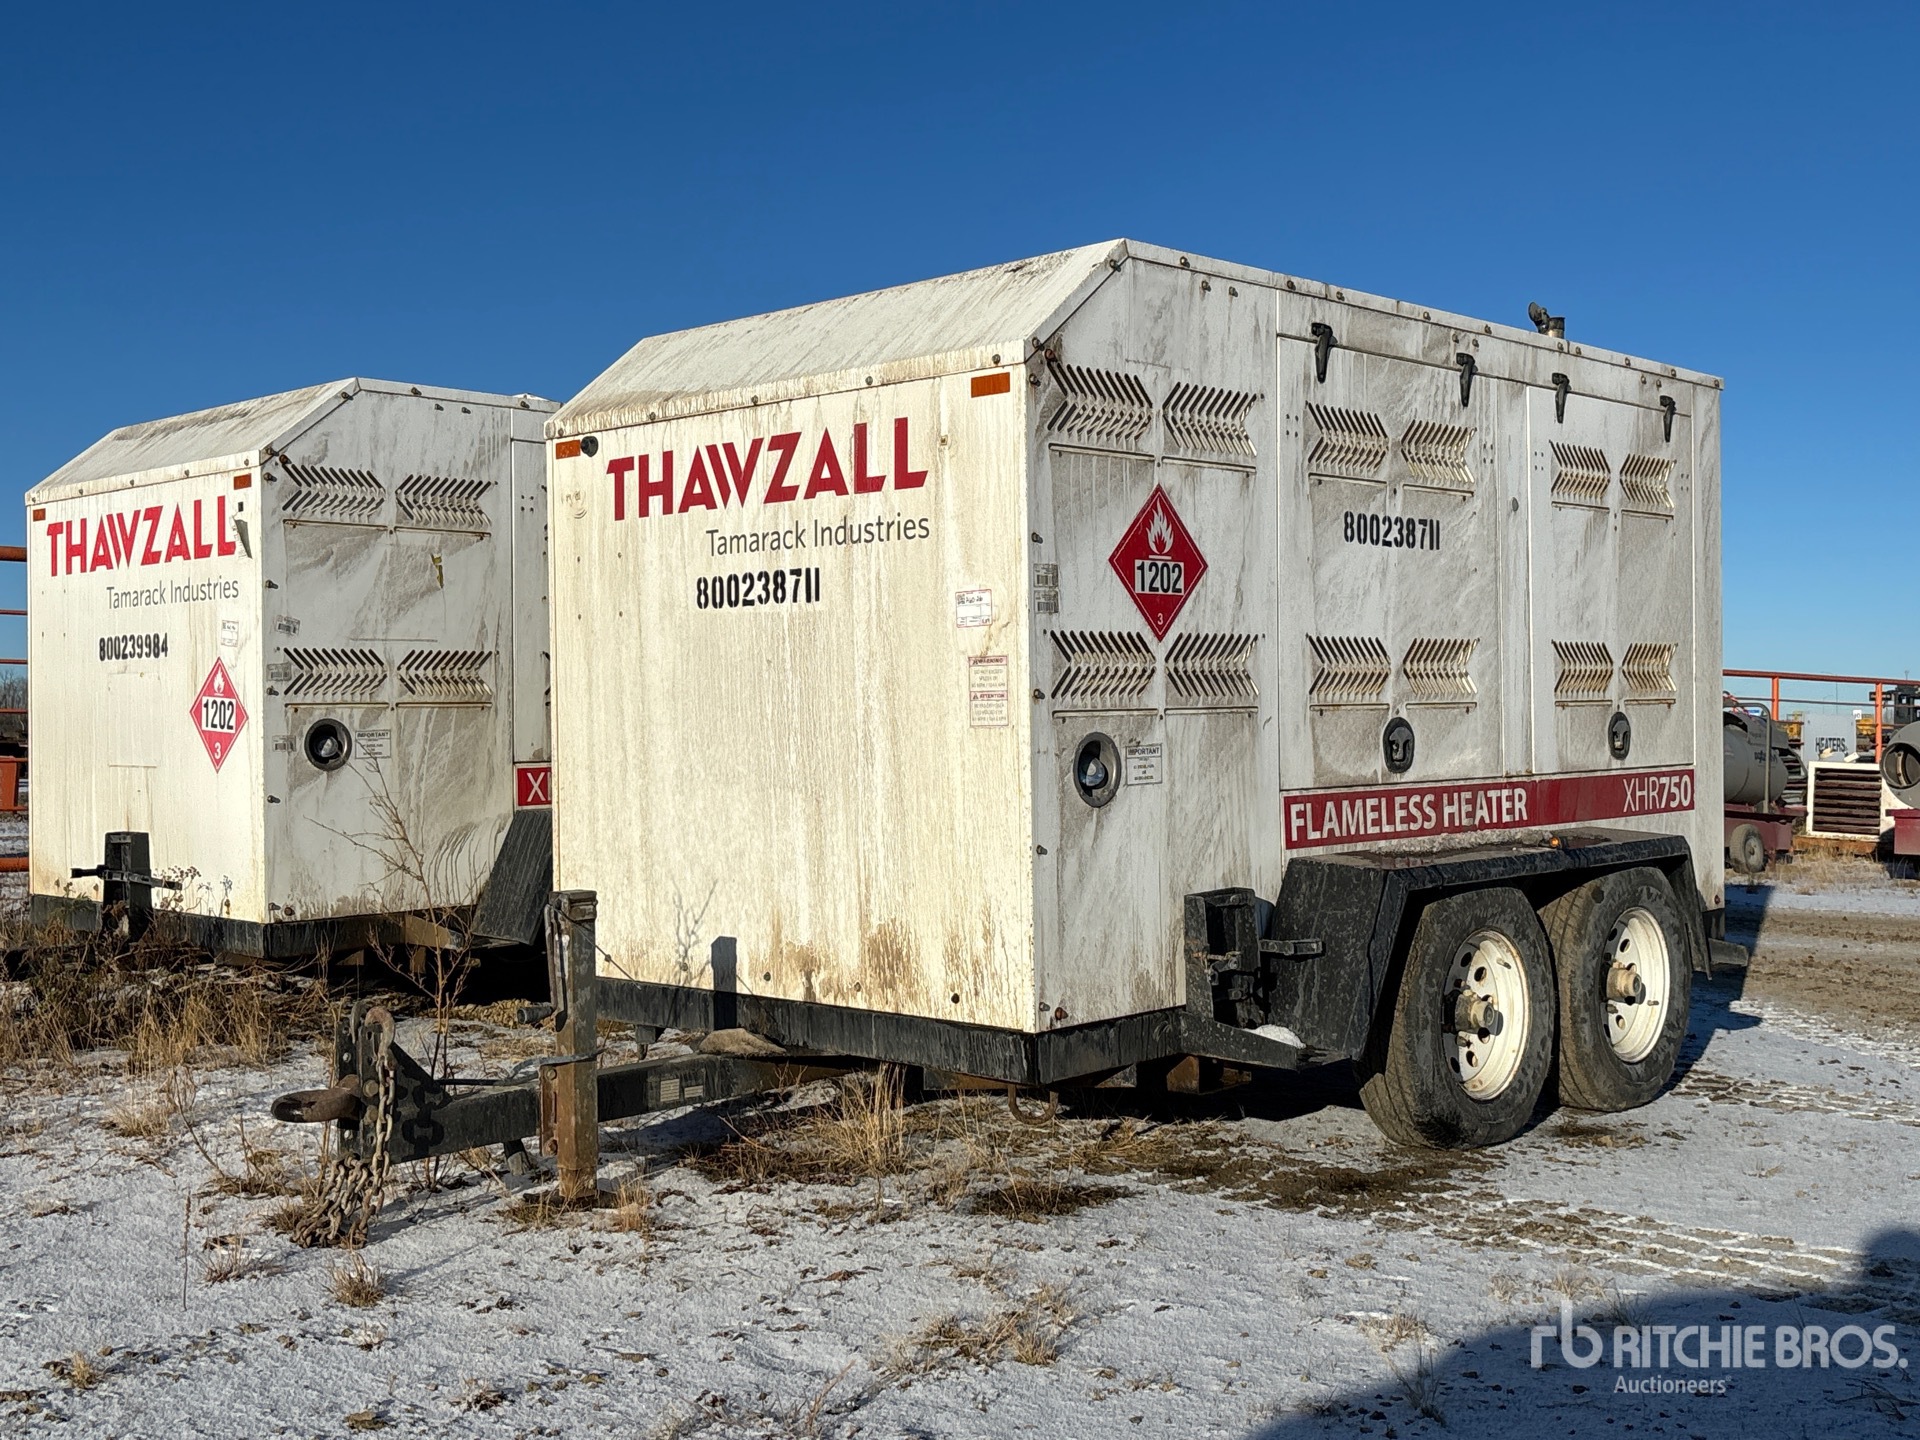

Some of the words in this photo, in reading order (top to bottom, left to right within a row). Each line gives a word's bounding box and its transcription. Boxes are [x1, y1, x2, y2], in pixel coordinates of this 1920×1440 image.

[606, 416, 929, 521] THAWZALL
[46, 495, 237, 577] THAWZALL
[706, 519, 806, 557] Tamarack
[813, 511, 930, 547] Industries
[1136, 561, 1183, 593] 1202
[106, 582, 166, 611] Tamarack
[169, 576, 239, 604] Industries
[1156, 612, 1164, 625] 3
[99, 632, 168, 662] 800239984
[203, 698, 234, 730] 1202
[214, 741, 222, 760] 3
[1127, 747, 1160, 756] IMPORTANT
[1815, 737, 1846, 753] HEATERS
[526, 771, 552, 802] X
[1622, 776, 1692, 813] XHR750
[1290, 794, 1436, 842] FLAMELESS
[1442, 787, 1528, 828] HEATER
